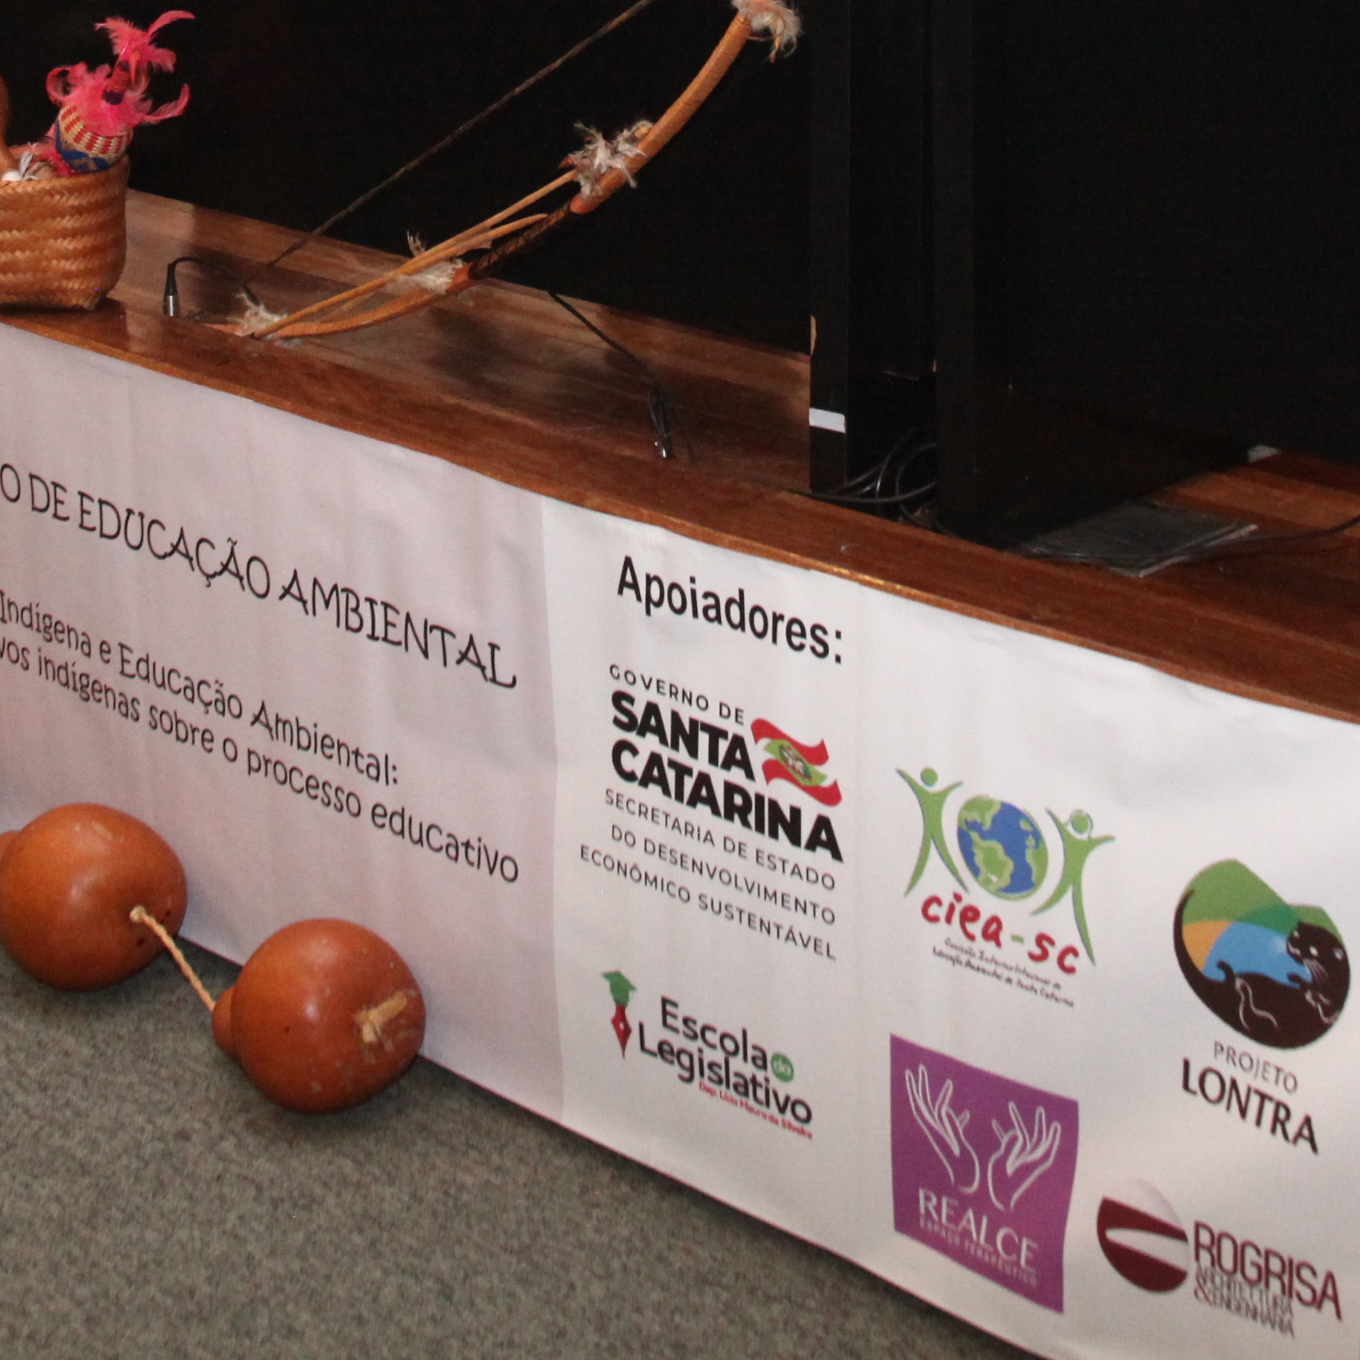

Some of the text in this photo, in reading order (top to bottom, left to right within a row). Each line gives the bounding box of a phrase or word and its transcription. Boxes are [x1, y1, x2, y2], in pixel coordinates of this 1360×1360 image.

[28, 471, 70, 522] DE
[77, 490, 270, 598] EDUCAÇÃO
[278, 569, 519, 690] AMBIENTAL
[617, 554, 843, 665] Apoiadores:
[98, 638, 111, 665] e
[117, 641, 243, 720] Educação
[250, 700, 399, 787] Ambiental:
[609, 663, 745, 725] GOVERNO DE
[610, 690, 756, 782] SANTA
[38, 648, 141, 723] indígenas
[147, 700, 216, 755] sobre
[221, 736, 238, 764] o
[246, 746, 362, 818] processo
[369, 801, 520, 884] educativo
[610, 739, 844, 863] CATARINA
[604, 788, 835, 891] SECRETARIA DE ESTADO
[610, 824, 835, 926] DO DESENVOLVIMENTO
[580, 845, 836, 960] ECONÔMICO SUSTENTÁVEL
[638, 1022, 813, 1127] Legislativo
[660, 996, 792, 1078] Escola do
[1213, 1041, 1298, 1094] PROJETO
[1182, 1057, 1319, 1154] LONTRA
[918, 1187, 1038, 1275] REALCE
[1194, 1221, 1342, 1321] ROGRISA
